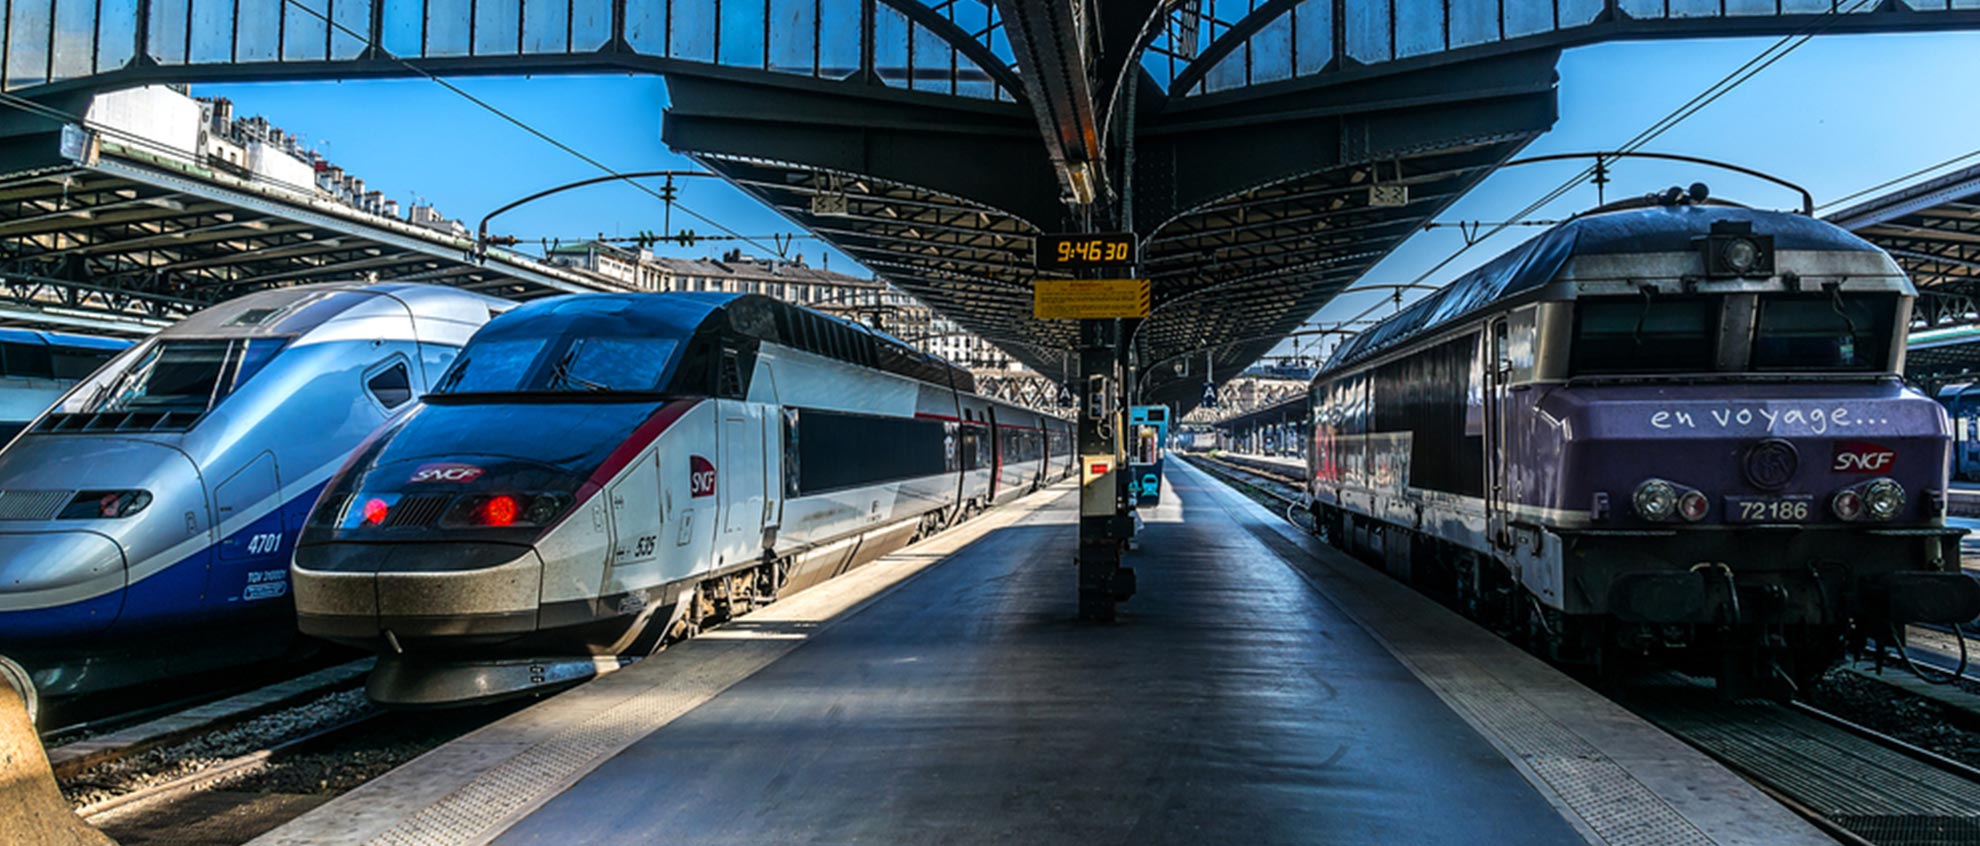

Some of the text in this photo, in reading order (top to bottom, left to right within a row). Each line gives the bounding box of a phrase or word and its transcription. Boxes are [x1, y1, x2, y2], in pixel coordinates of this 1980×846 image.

[1057, 240, 1129, 262] 9:46 30
[1059, 386, 1071, 399] A
[1203, 386, 1216, 398] A
[1651, 407, 1888, 434] en voyage...
[1833, 451, 1894, 471] SNCF
[410, 467, 483, 482] SNCF
[692, 470, 716, 493] SNCF
[1739, 501, 1808, 520] 72186
[247, 532, 283, 555] 4701
[634, 535, 657, 557] 535
